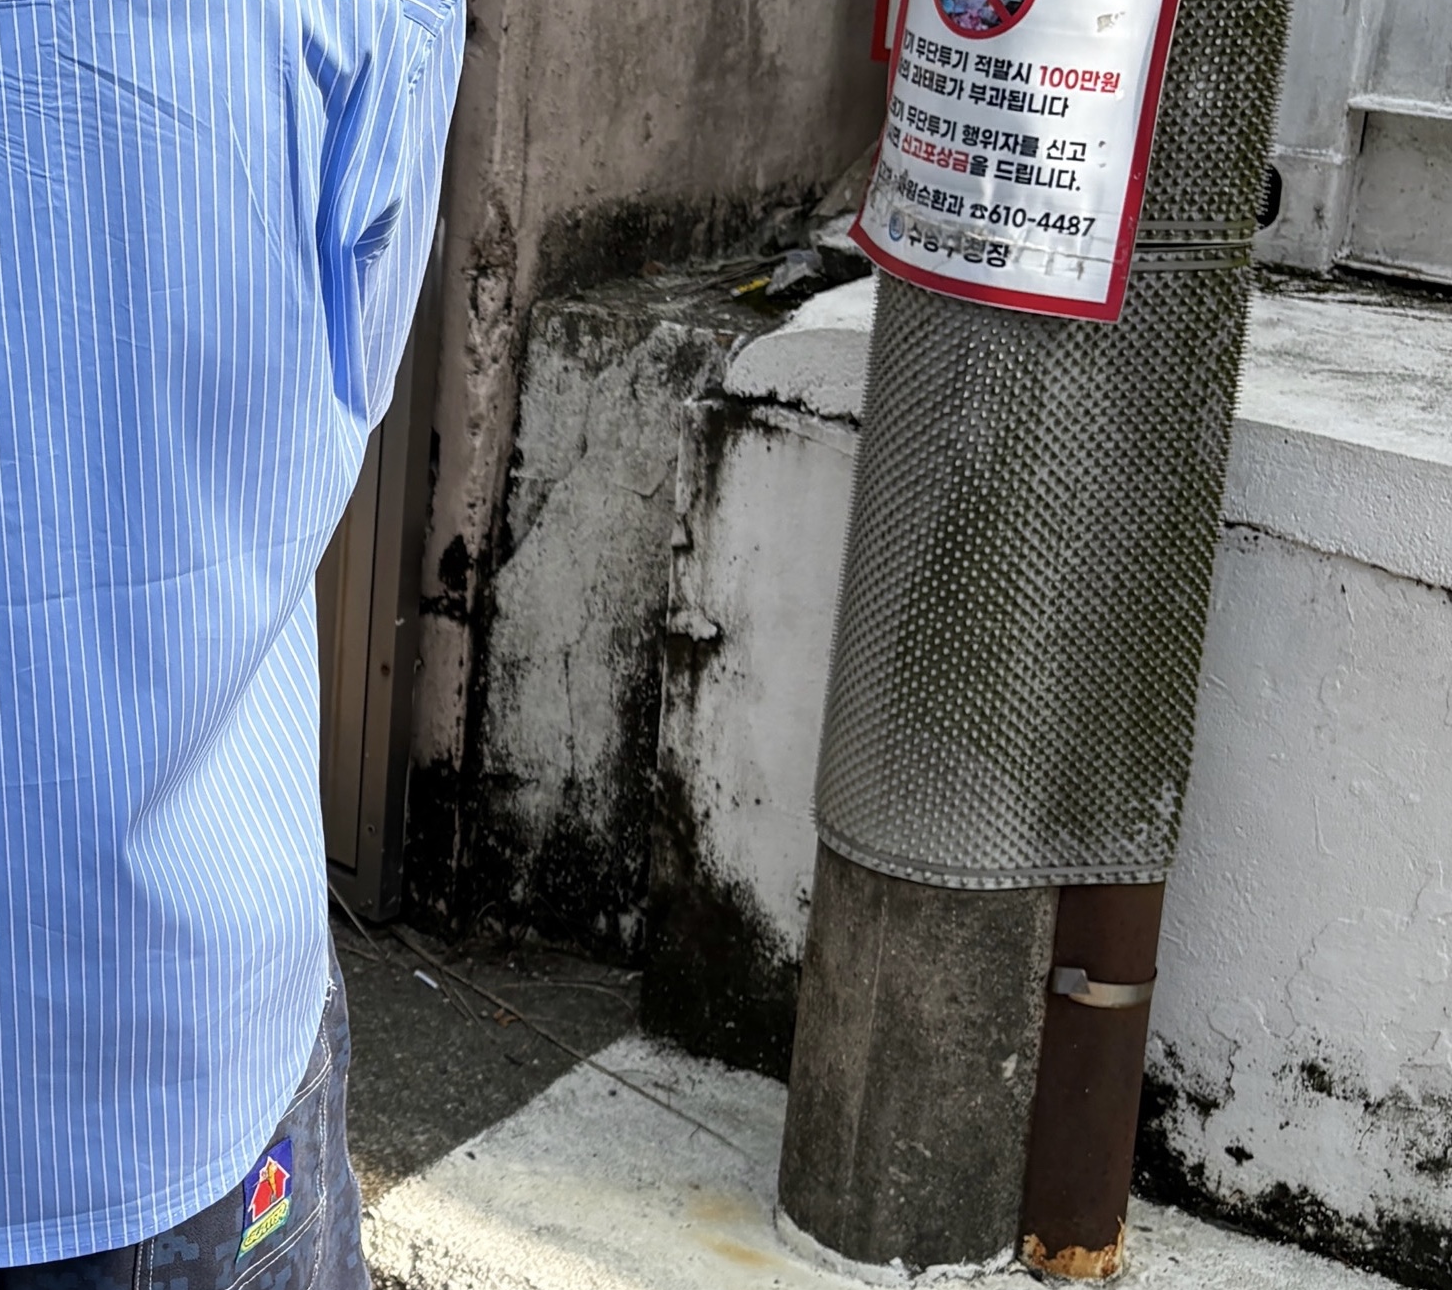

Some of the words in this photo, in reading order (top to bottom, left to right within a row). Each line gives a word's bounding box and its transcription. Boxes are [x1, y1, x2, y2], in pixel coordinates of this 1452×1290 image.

[911, 64, 965, 100] 과태료가
[968, 82, 1069, 118] 부과됩니다
[915, 37, 969, 72] 무단투기
[974, 54, 1033, 84] 적발시
[1038, 65, 1121, 93] 100만원
[901, 132, 988, 177] 신고포상금을
[993, 159, 1081, 191] 드립니다.
[906, 105, 957, 141] 무단투기
[962, 124, 1040, 158] 행위자를
[1046, 139, 1088, 162] 신고
[988, 204, 1097, 237] 610-4487
